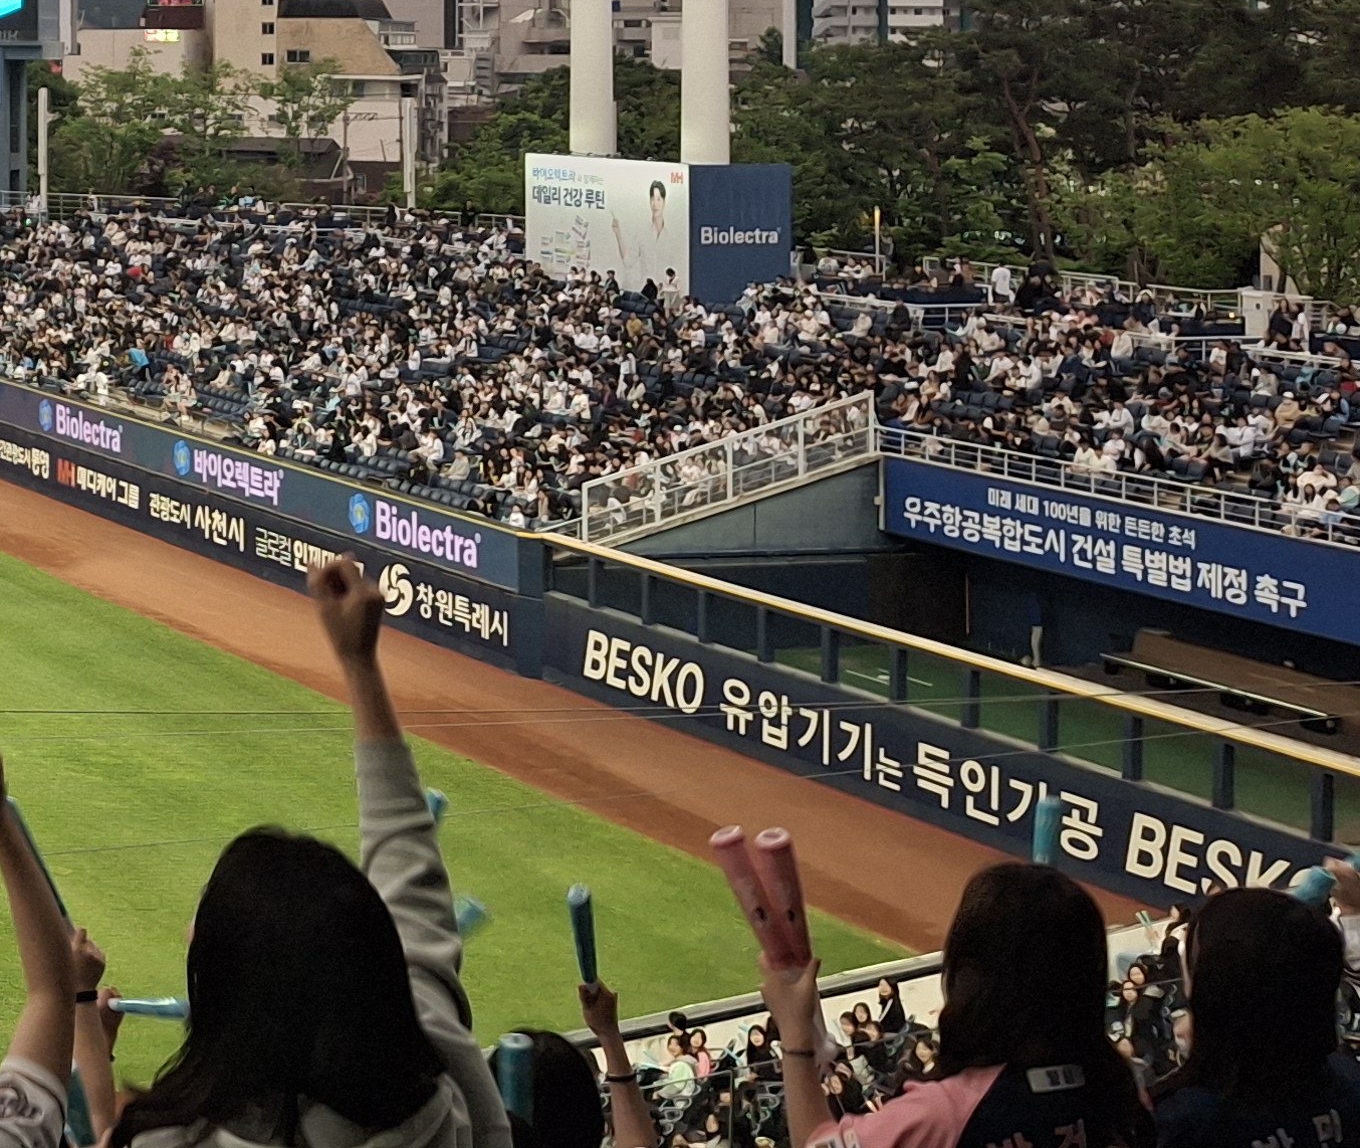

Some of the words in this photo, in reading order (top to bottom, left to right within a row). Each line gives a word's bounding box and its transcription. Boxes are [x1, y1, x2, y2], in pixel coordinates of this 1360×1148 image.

[532, 185, 561, 205] 데일리
[563, 187, 583, 207] 건강
[584, 189, 605, 210] 루틴
[700, 226, 778, 245] Biolectra
[55, 403, 122, 453] Biolectra
[193, 449, 278, 506] 바이오렉트라
[149, 492, 191, 529] 관광도시
[194, 504, 245, 552] 사천시
[255, 526, 292, 568] 글로컬
[375, 500, 479, 568] Biolectra
[988, 486, 1012, 511] 미래
[1015, 492, 1039, 517] 세대
[1042, 499, 1091, 528] 100년을
[1095, 511, 1122, 536] 위한
[1124, 516, 1165, 544] 든든한
[1168, 525, 1196, 550] 초석
[903, 496, 1067, 564] 우주항공복합도시
[1072, 532, 1116, 575] 건설
[1121, 544, 1192, 592] 특별법
[1197, 561, 1248, 605] 제정
[1254, 574, 1308, 618] 촉구
[416, 583, 509, 647] 창원특례시
[583, 629, 705, 715] BESKO
[1125, 812, 1302, 896] BESK
